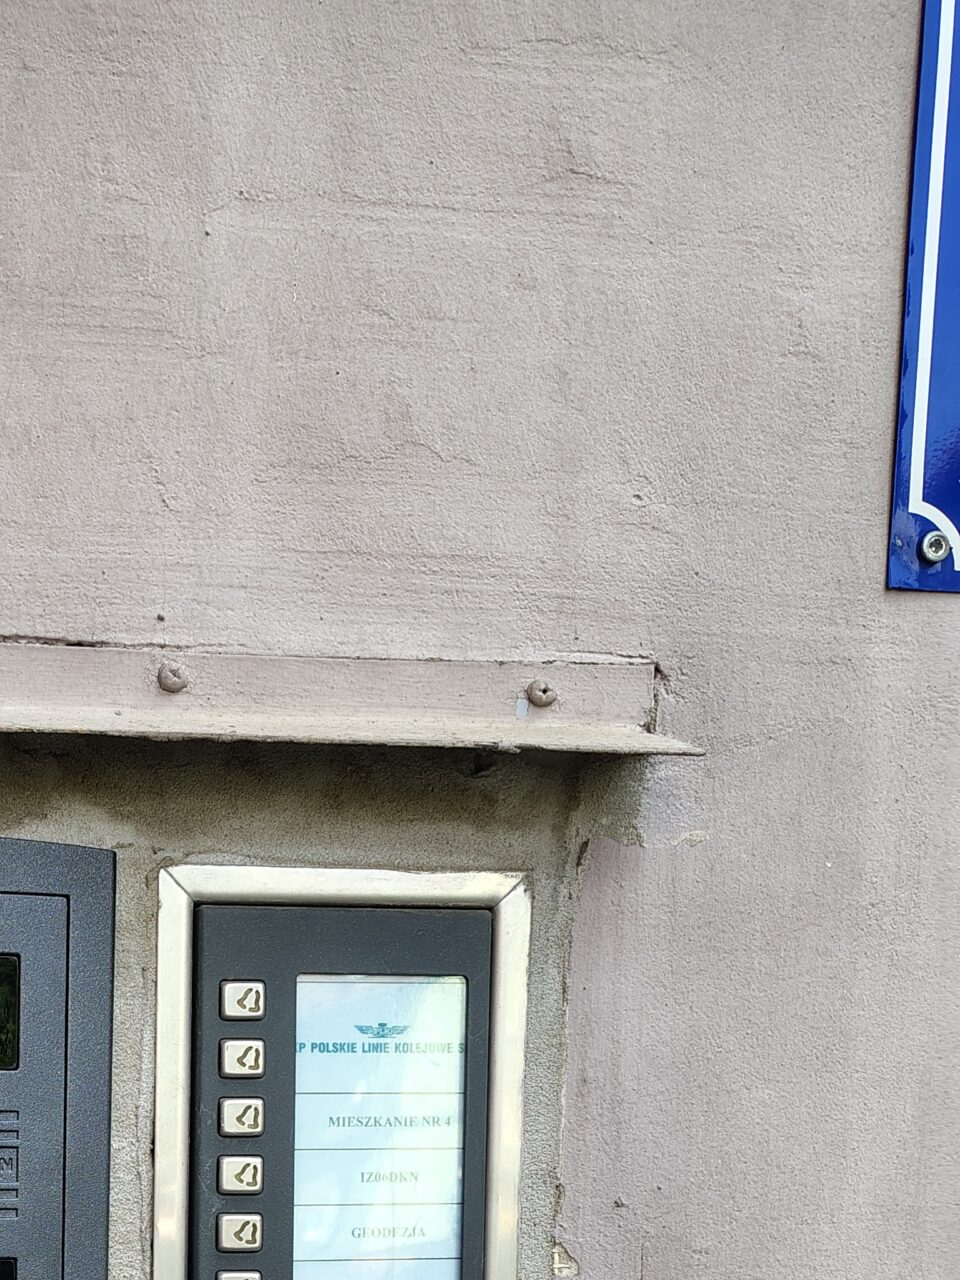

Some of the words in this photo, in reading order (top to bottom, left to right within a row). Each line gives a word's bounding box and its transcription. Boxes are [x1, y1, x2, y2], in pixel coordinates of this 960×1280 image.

[311, 1042, 357, 1054] POLSKIE
[362, 1042, 390, 1054] LINIE
[394, 1042, 453, 1054] KOLEJOWE
[328, 1116, 418, 1128] MIESZKANIE
[421, 1116, 441, 1128] NR
[445, 1116, 451, 1127] 4
[351, 1227, 426, 1239] GEODEZJA
